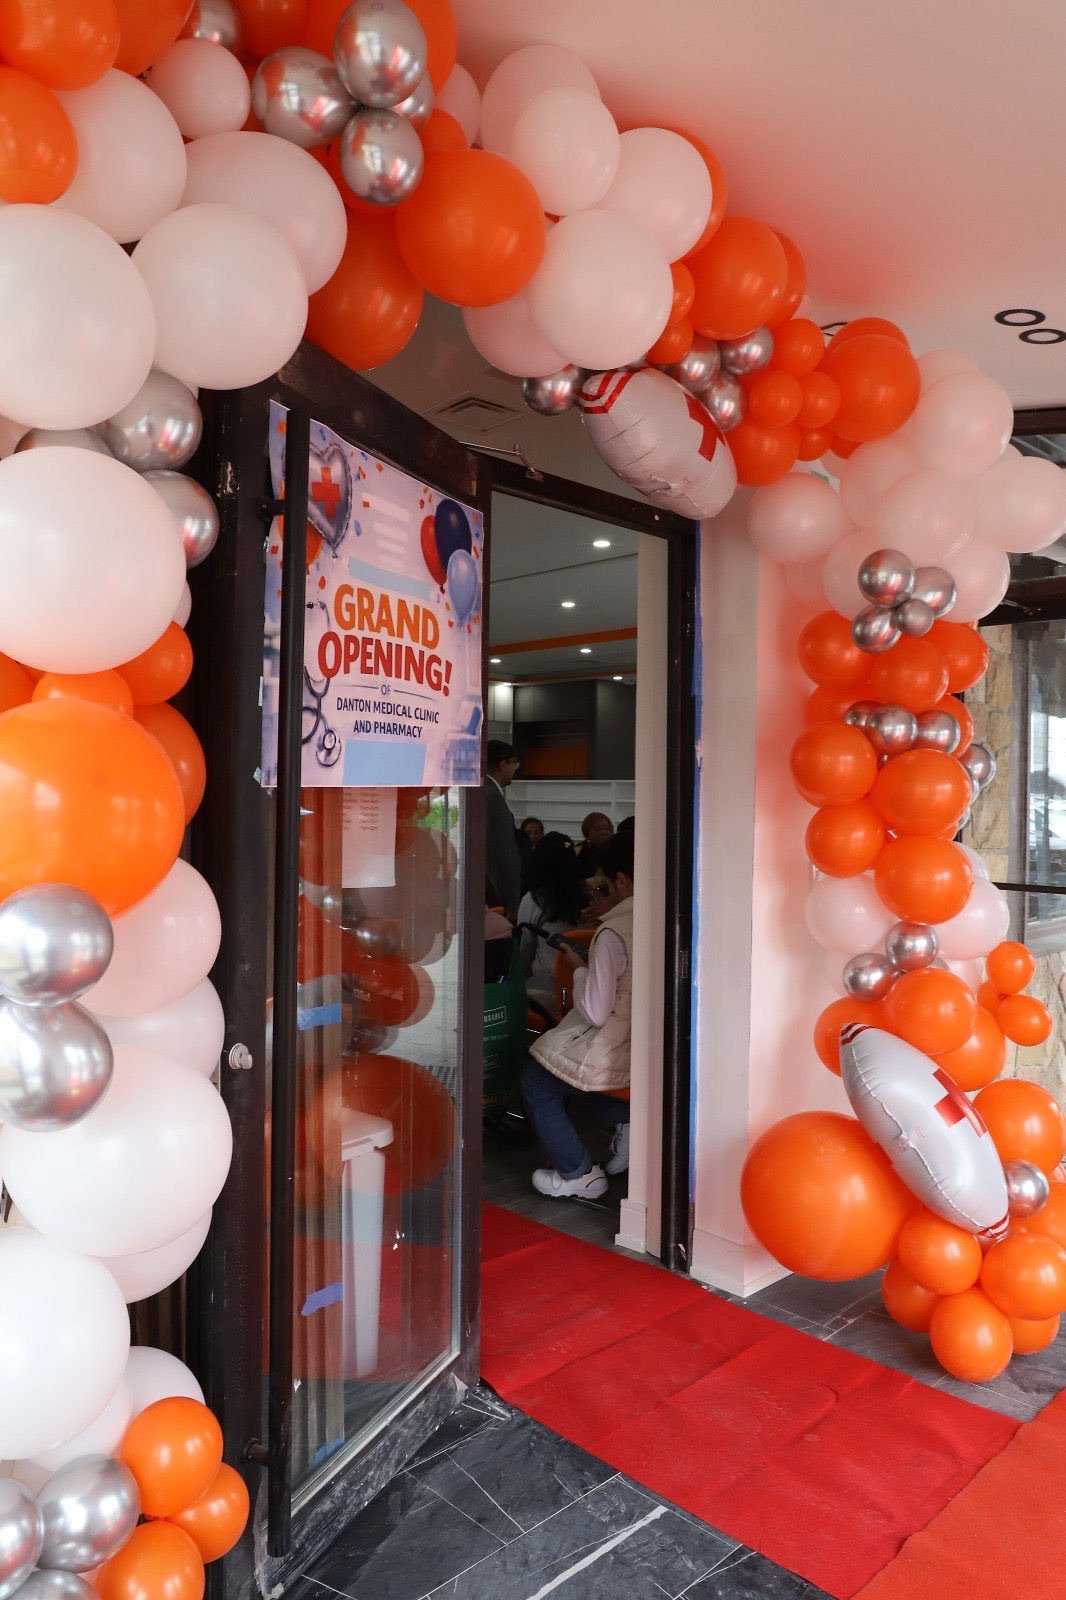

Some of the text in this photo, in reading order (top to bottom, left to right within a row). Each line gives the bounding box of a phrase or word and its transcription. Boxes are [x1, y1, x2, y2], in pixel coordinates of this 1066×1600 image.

[334, 583, 440, 650] GRAND
[317, 631, 453, 697] OPENING!
[380, 684, 391, 696] OF
[336, 697, 440, 724] DANTON MEDICAL CLINIC
[353, 720, 423, 738] AND PHARMACY
